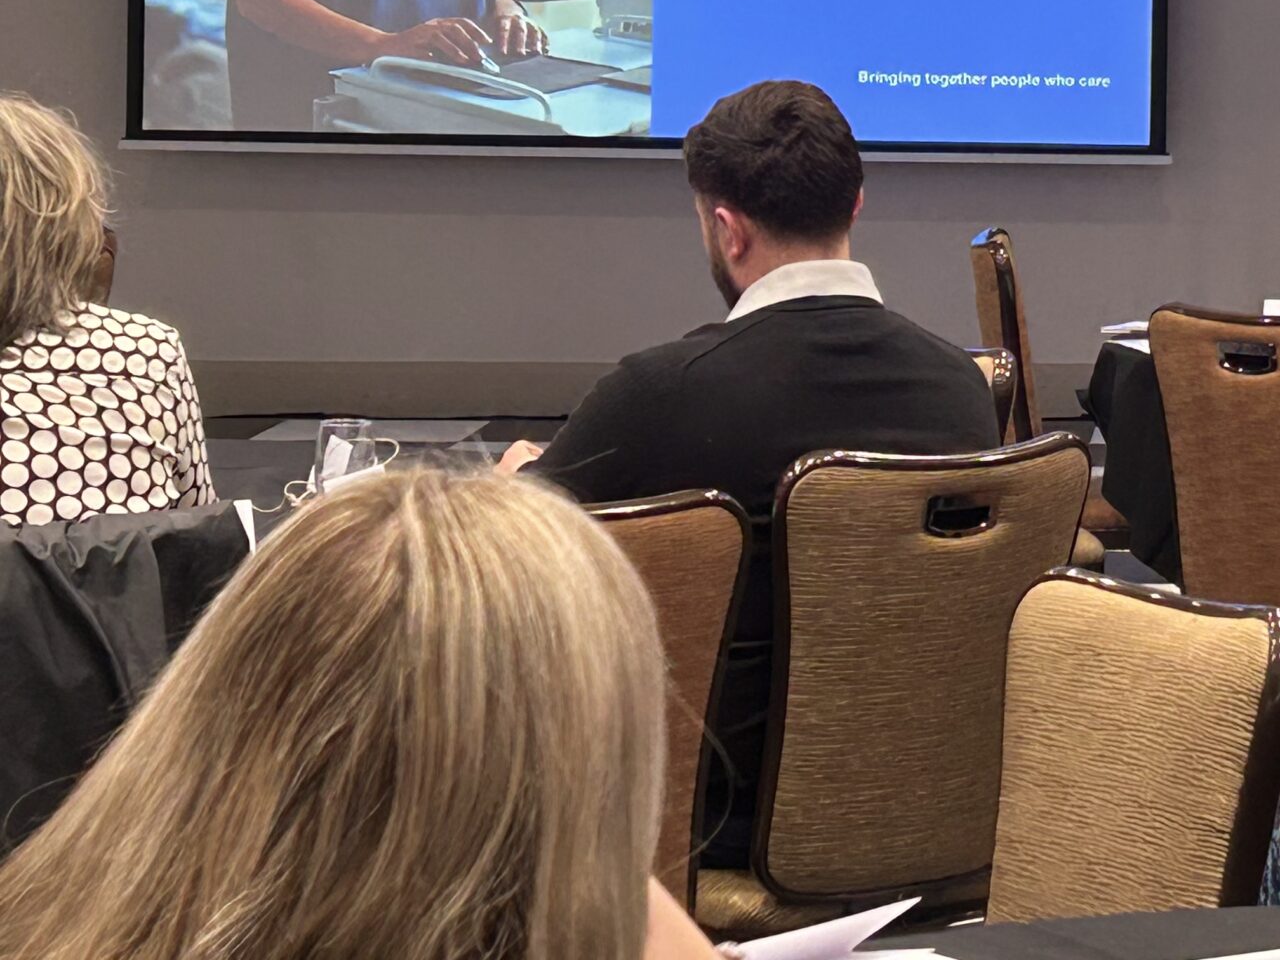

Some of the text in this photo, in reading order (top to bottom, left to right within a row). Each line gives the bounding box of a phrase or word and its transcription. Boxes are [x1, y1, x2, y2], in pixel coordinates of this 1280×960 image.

[858, 70, 1111, 89] Bringing together people who care
